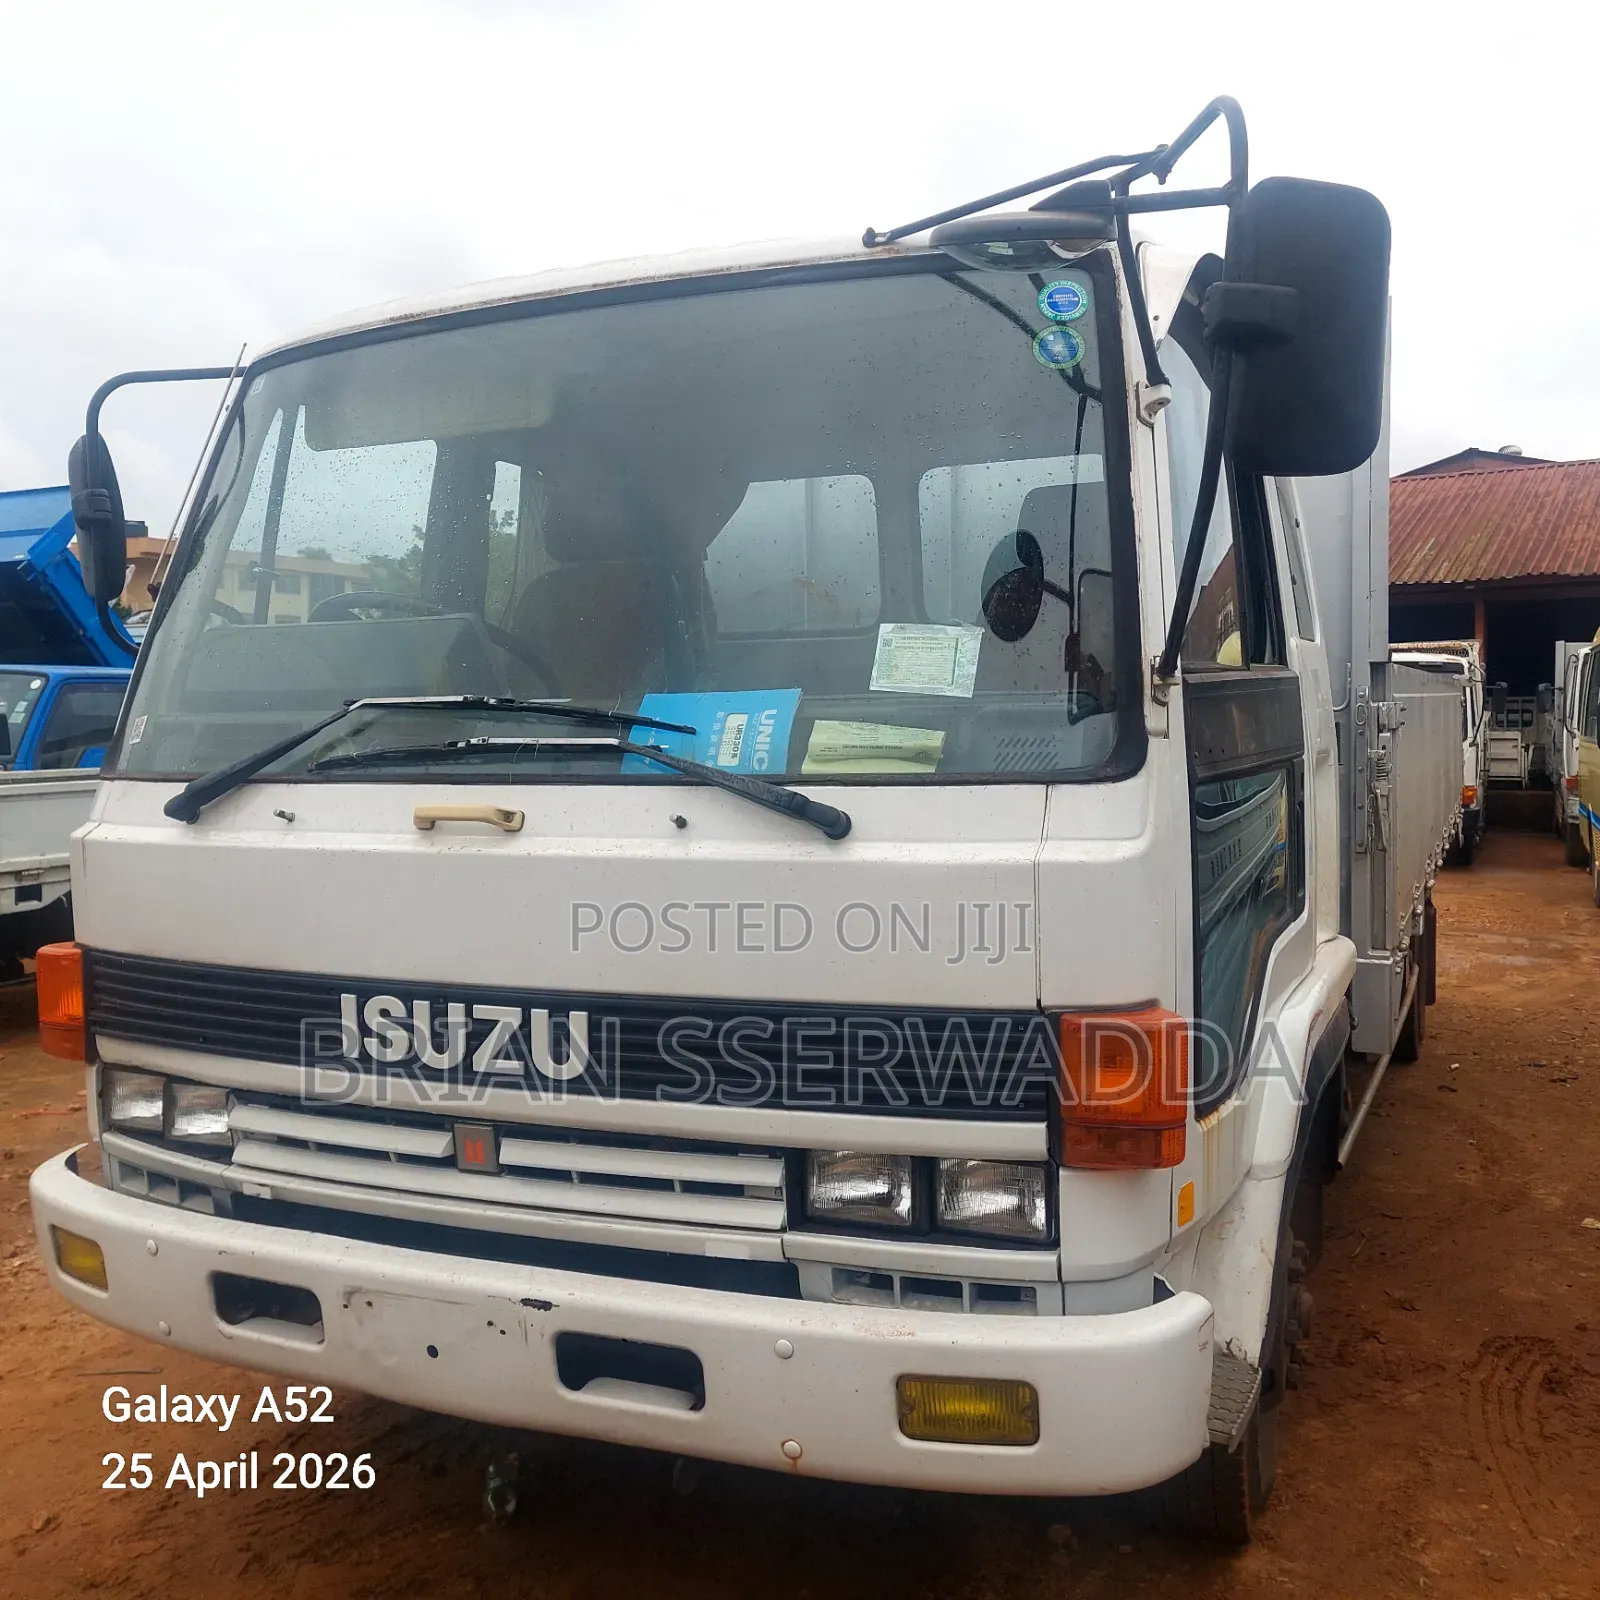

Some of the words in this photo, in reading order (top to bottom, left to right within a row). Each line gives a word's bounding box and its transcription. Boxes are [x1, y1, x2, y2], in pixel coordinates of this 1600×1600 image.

[1039, 280, 1059, 300] QUALITY
[1060, 280, 1087, 304] INSPECTION
[753, 709, 777, 771] UNIC
[340, 993, 590, 1081] ISUZU
